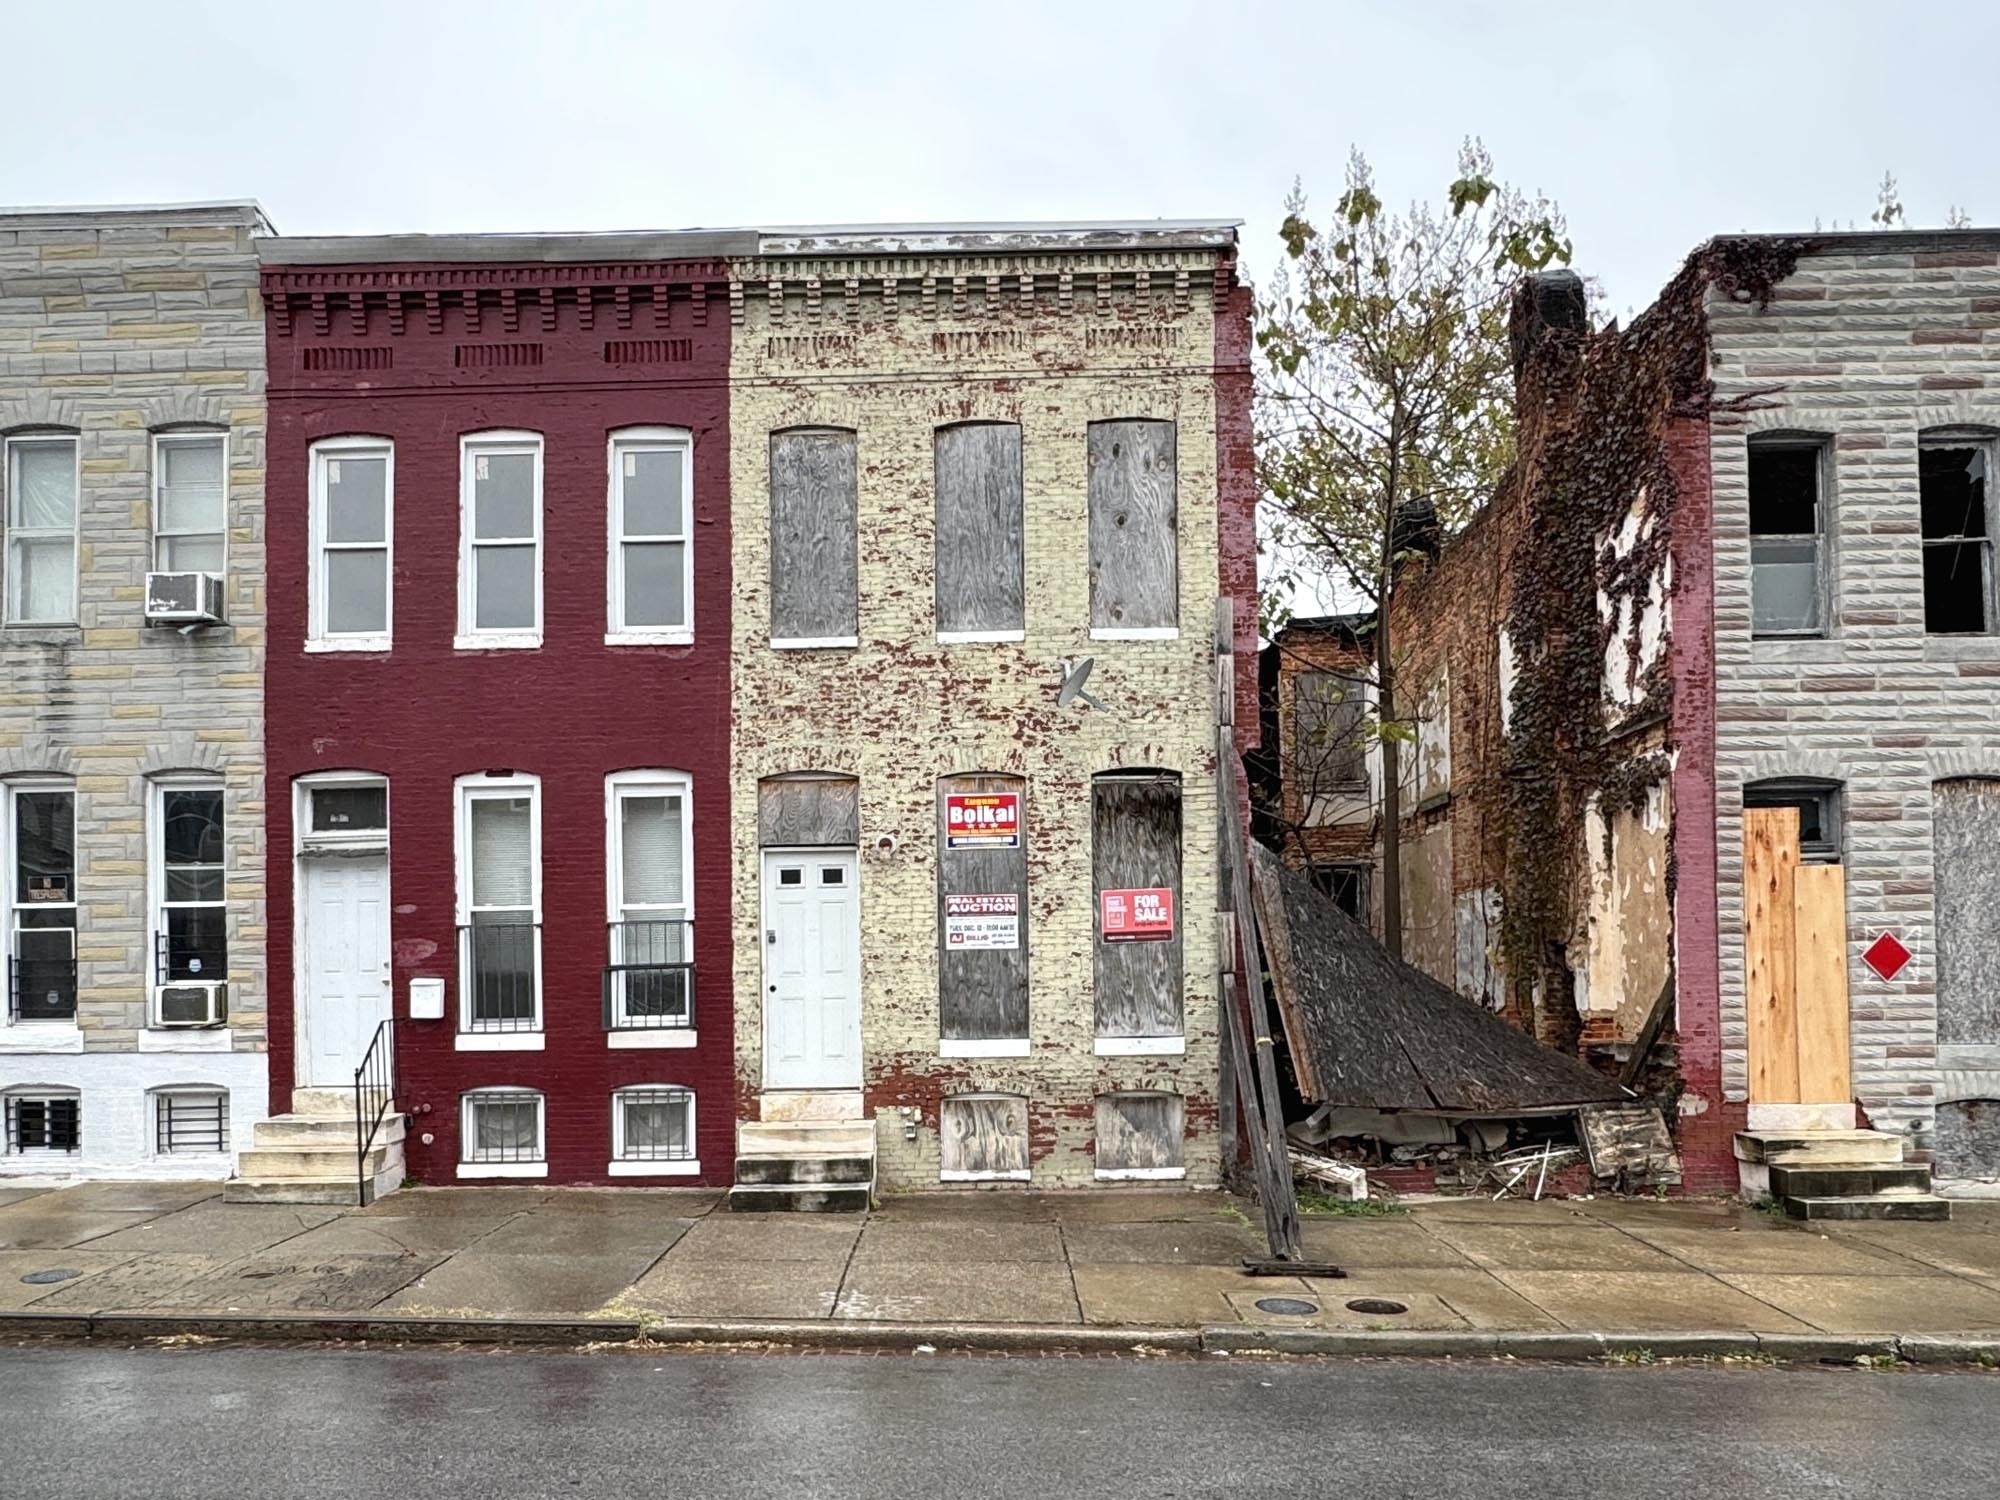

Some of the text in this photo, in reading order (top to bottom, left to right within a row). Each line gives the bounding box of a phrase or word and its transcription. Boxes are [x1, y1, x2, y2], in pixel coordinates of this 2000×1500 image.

[1134, 895, 1160, 908] FOR
[948, 903, 1016, 912] AUCTION
[1135, 907, 1168, 921] SALE
[951, 934, 963, 942] AJ
